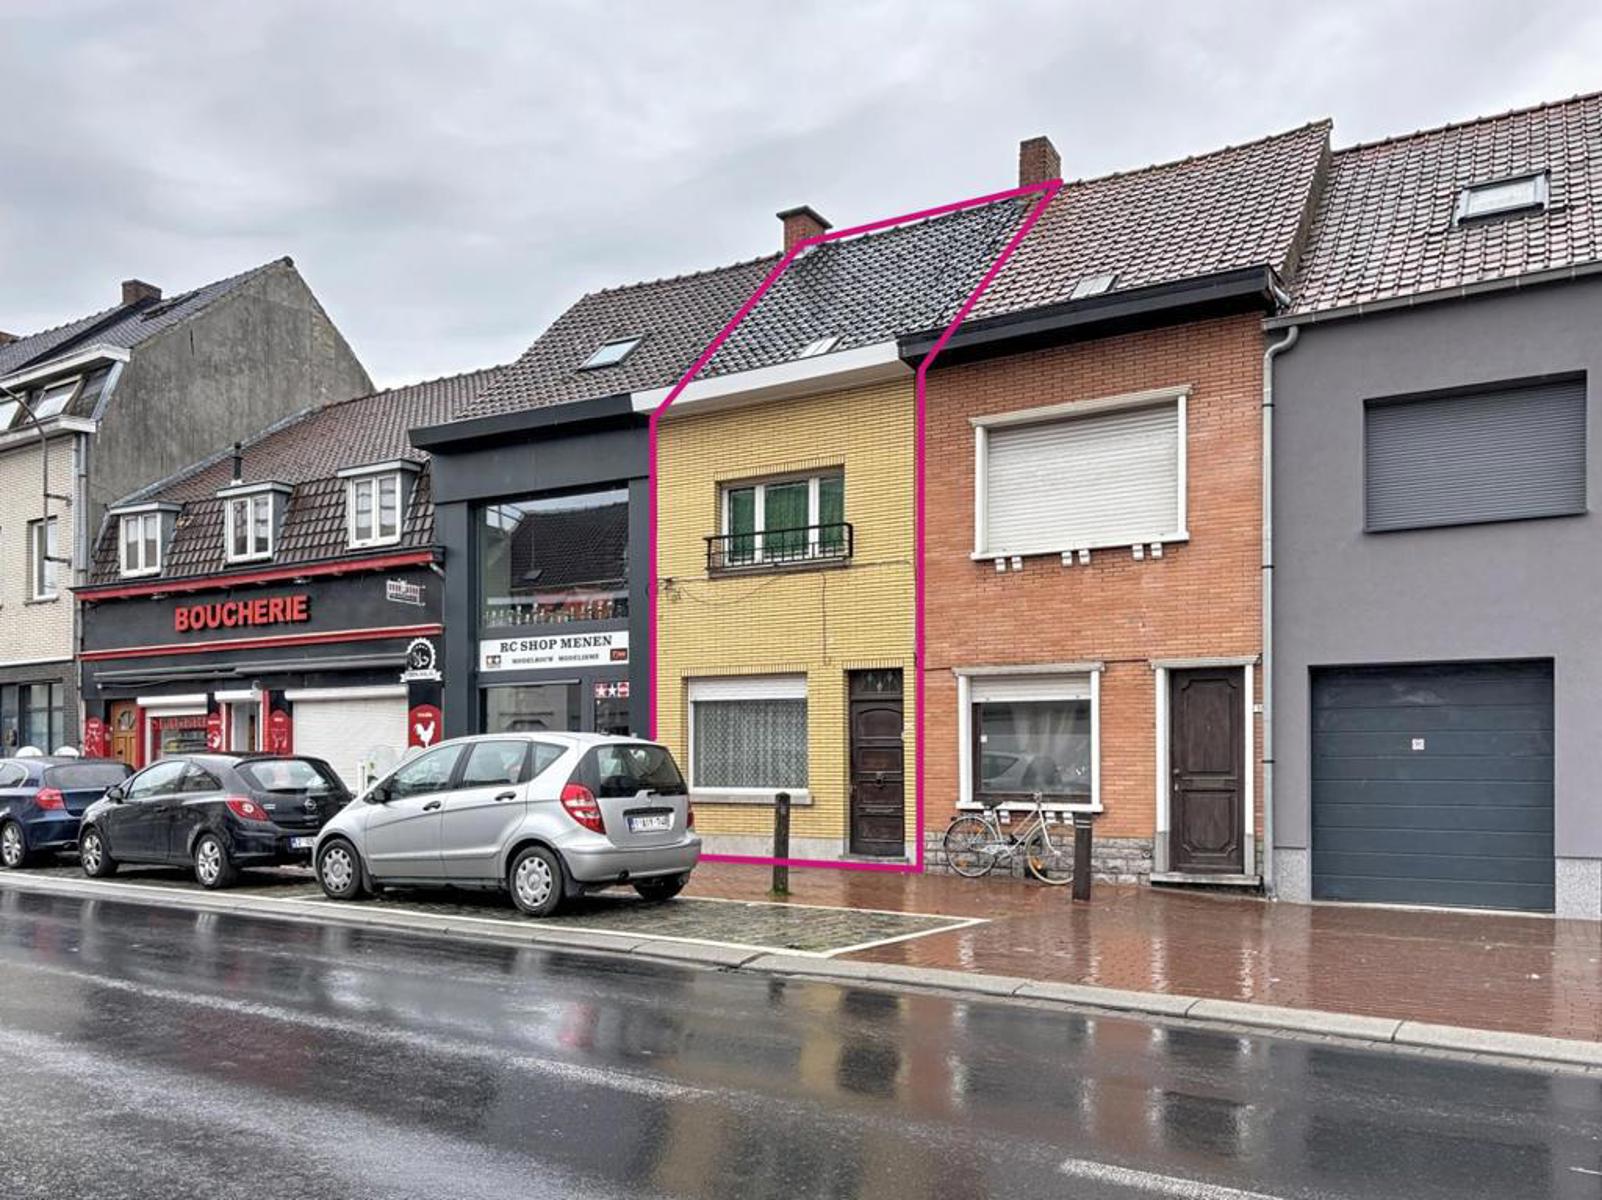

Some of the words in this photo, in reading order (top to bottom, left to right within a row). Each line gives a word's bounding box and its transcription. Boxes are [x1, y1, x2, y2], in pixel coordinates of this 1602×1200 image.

[174, 594, 308, 631] BOUCHERIE
[500, 641, 518, 653] RC
[520, 638, 557, 651] SHOP
[560, 635, 613, 649] MENEN
